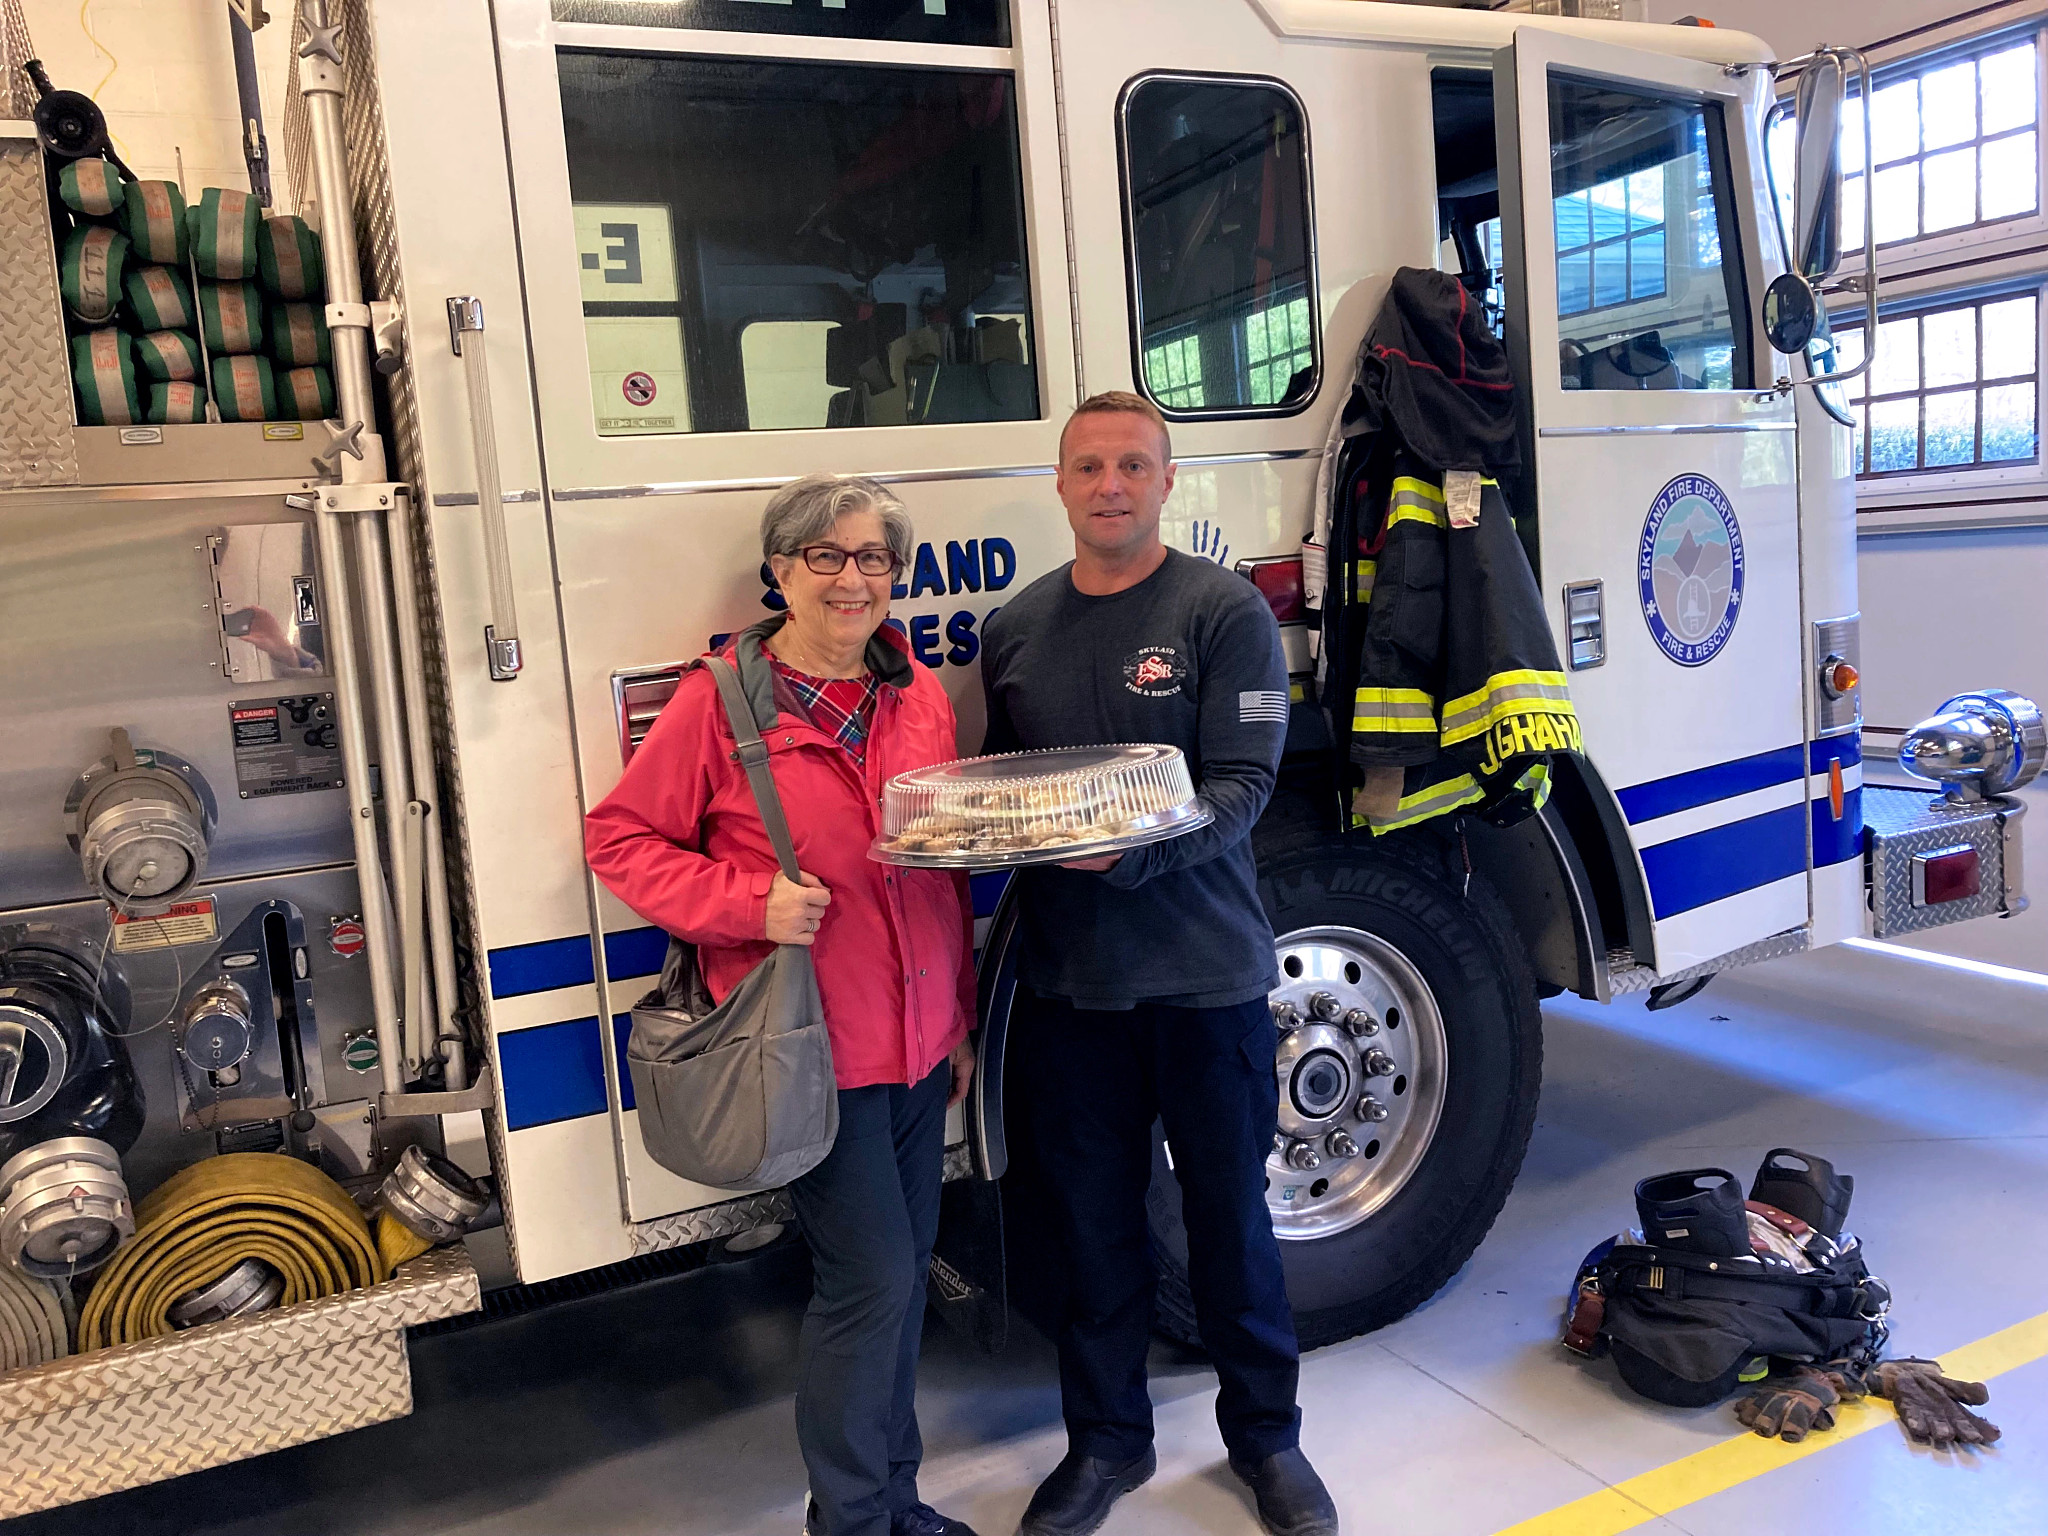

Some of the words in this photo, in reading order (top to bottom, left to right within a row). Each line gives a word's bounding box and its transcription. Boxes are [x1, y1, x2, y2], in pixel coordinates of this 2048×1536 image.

[1641, 498, 1668, 581] SKYLAND
[1668, 480, 1693, 503] FIRE
[1695, 480, 1744, 572] DEPARTMENT
[1662, 630, 1685, 658] FIRE
[1686, 646, 1693, 660] &
[1695, 615, 1731, 659] RESCUE
[1125, 681, 1143, 695] FIRE
[1151, 684, 1182, 697] RESCUE
[243, 709, 274, 718] DANGER
[1479, 712, 1585, 776] J.GRAHA
[253, 784, 304, 796] EQUIPMENT
[307, 781, 331, 790] RACK
[271, 776, 313, 787] POWERED
